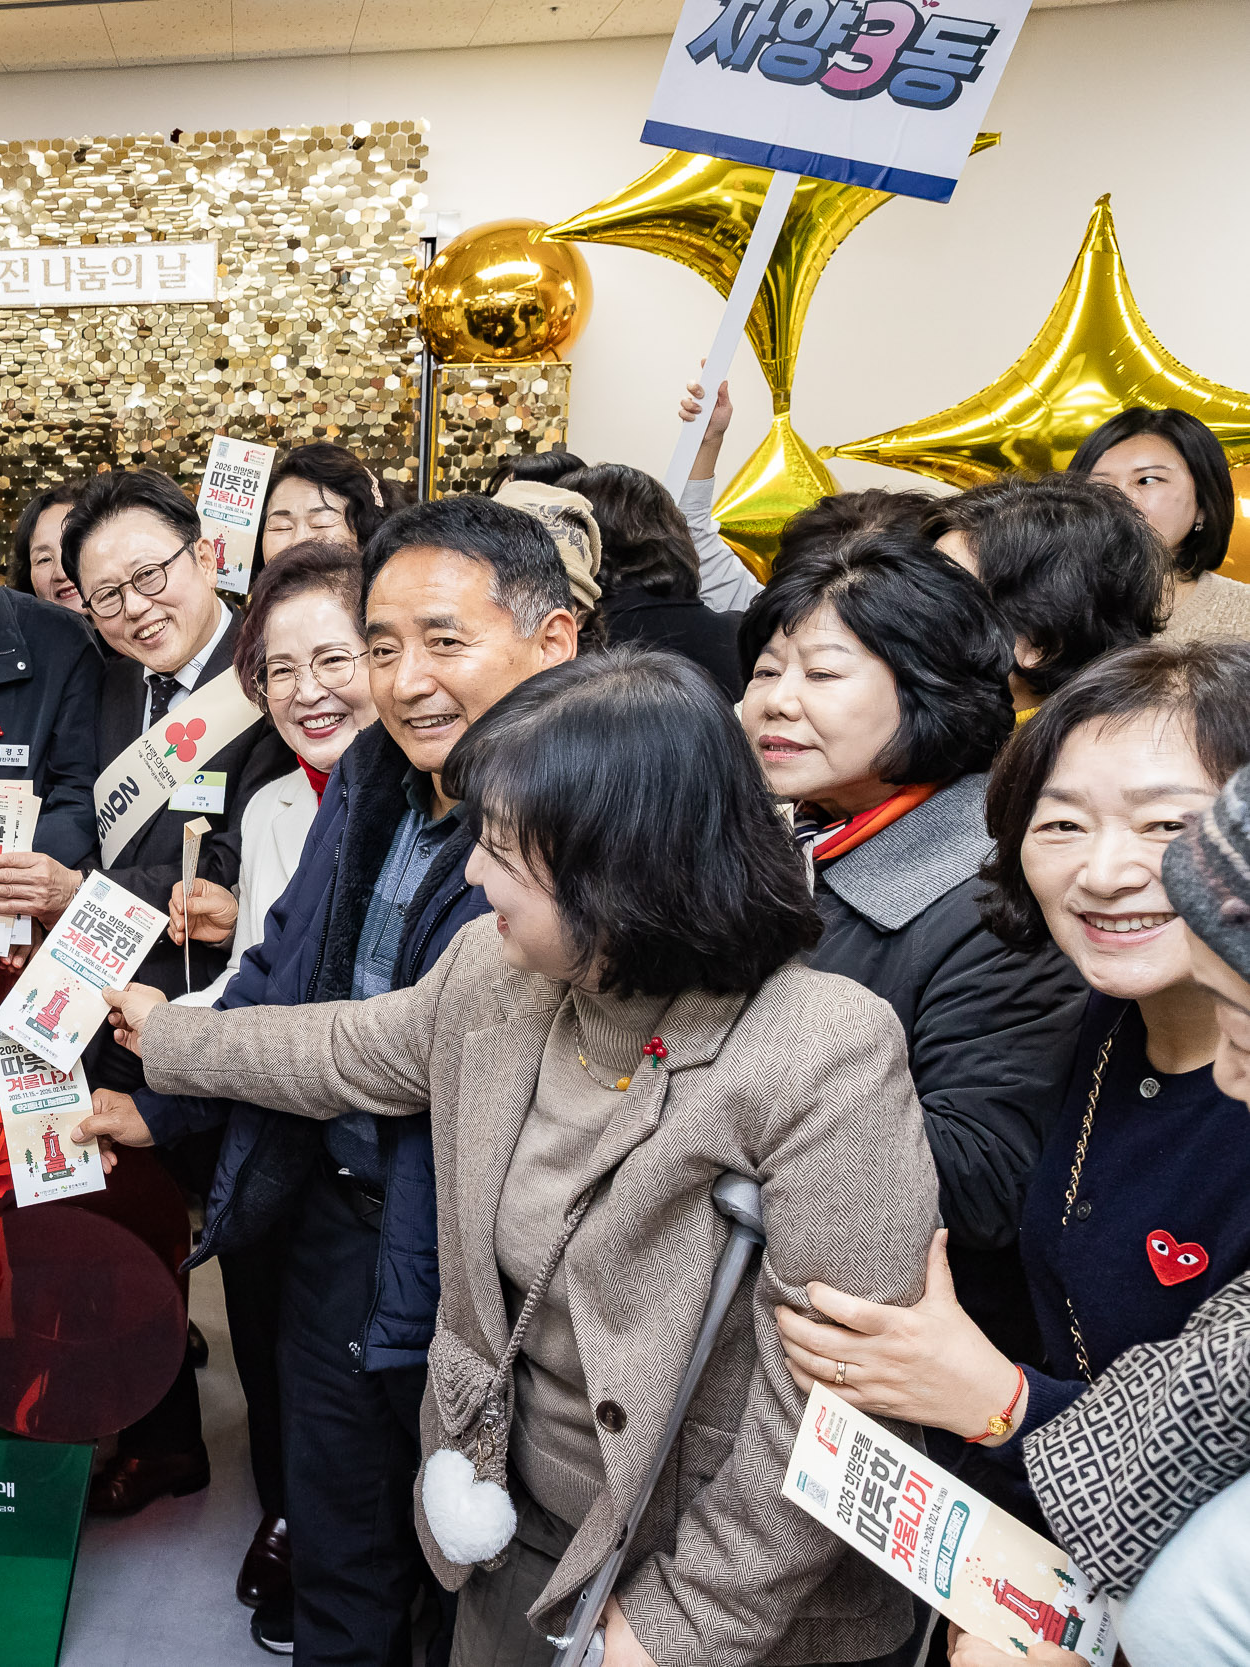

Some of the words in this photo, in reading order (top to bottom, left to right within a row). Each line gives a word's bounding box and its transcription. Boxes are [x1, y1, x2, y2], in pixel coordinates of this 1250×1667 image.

[685, 0, 1001, 111] 자양3동
[41, 254, 143, 292] 나눔의
[156, 252, 190, 289] 날
[209, 471, 259, 497] 따뜻한
[214, 461, 232, 472] 2026
[233, 465, 261, 480] 희망온돌
[206, 487, 254, 509] 겨울나기
[70, 909, 137, 961] 따뜻한
[83, 900, 108, 919] 2026
[106, 915, 144, 944] 희망온돌
[62, 926, 125, 975] 겨울나기
[0, 1043, 26, 1056] 2026
[1, 1054, 54, 1076] 따뜻
[844, 1431, 873, 1490] 희망온돌
[837, 1486, 856, 1525] 2026
[856, 1447, 906, 1552] 따뜻한
[891, 1470, 934, 1572] 겨울나기
